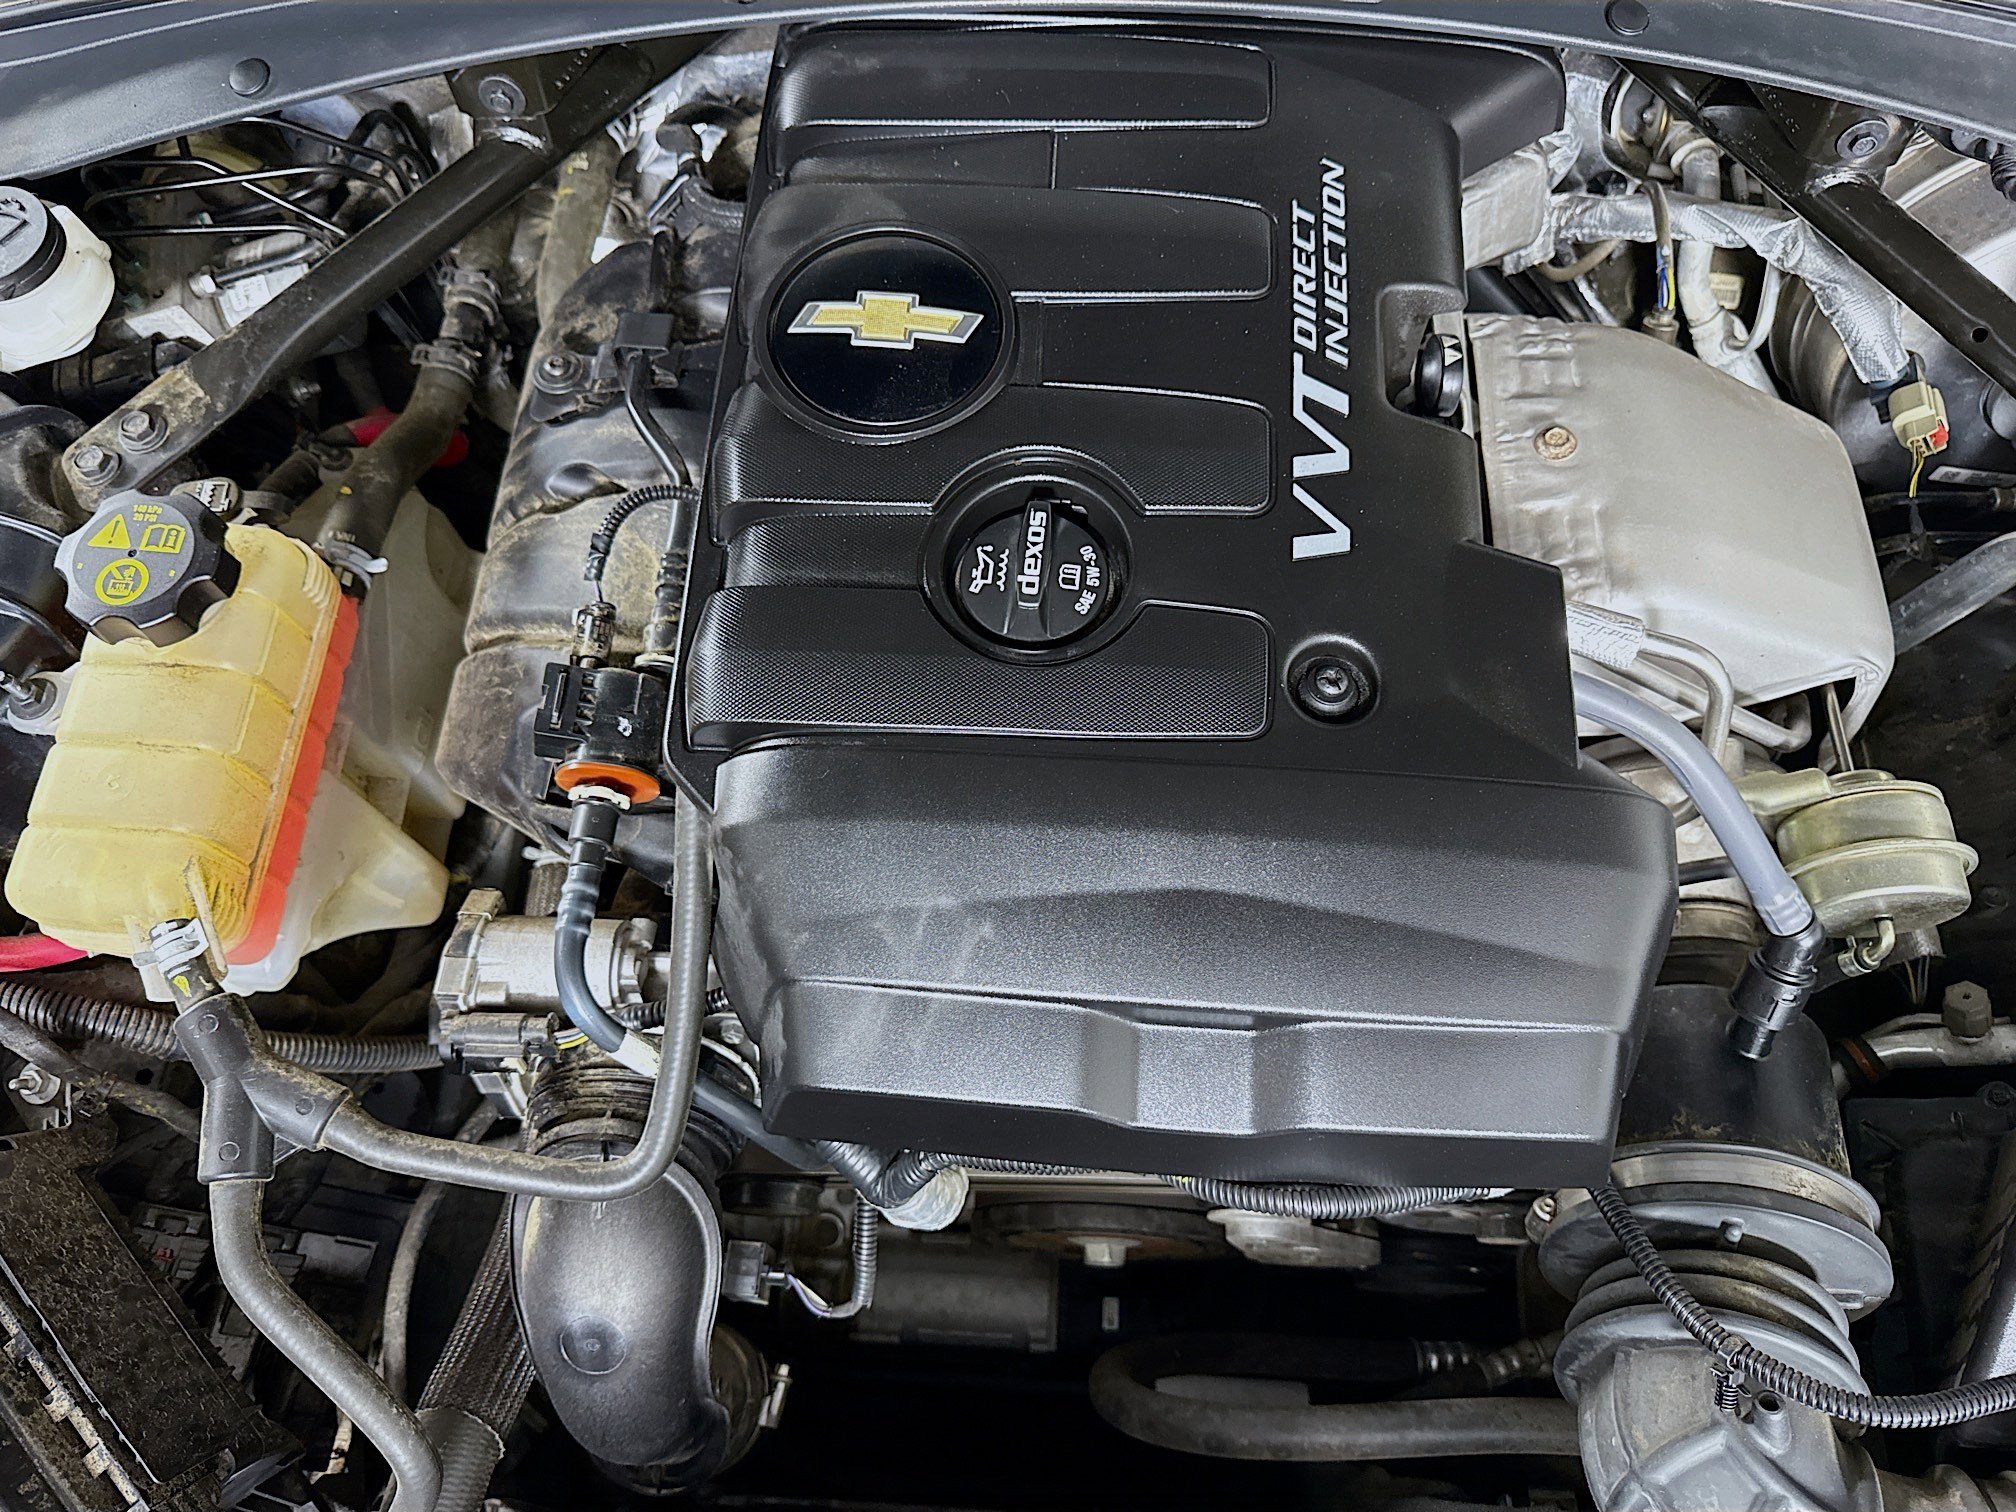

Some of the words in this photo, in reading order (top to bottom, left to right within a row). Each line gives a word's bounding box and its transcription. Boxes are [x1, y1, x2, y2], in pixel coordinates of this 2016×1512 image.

[1292, 198, 1318, 351] DIRECT
[1320, 157, 1349, 367] INJECTION
[1292, 352, 1351, 560] VVT
[1017, 510, 1047, 595] dexos
[1073, 589, 1097, 615] SAE
[1079, 545, 1101, 587] 5W-30
